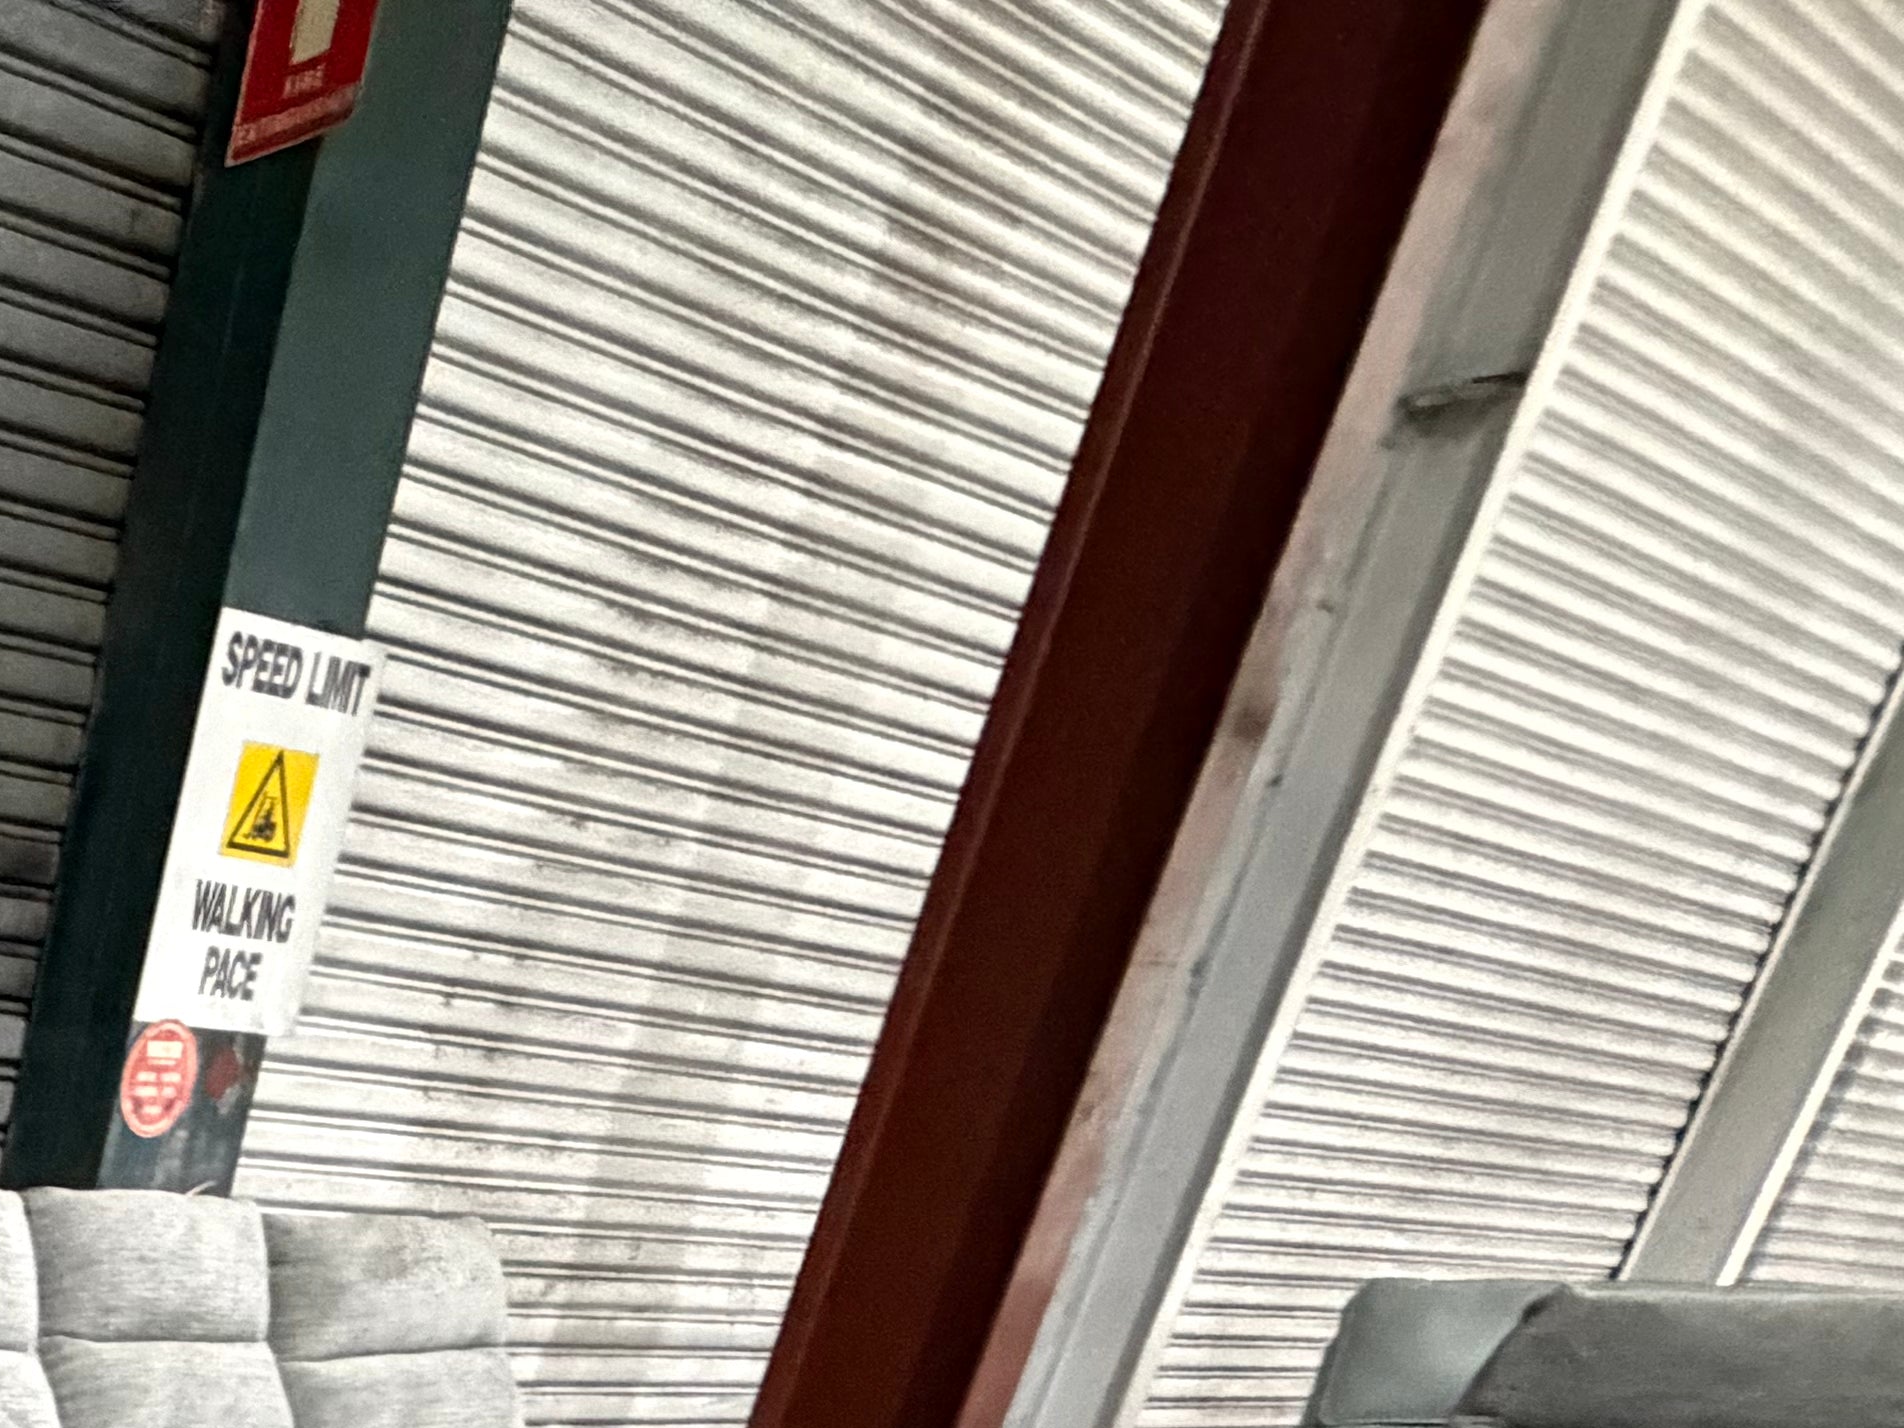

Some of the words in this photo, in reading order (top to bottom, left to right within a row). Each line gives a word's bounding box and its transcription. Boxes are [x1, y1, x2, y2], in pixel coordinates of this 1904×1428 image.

[221, 631, 304, 699] SPEED
[305, 651, 371, 717] LIMIT
[192, 878, 295, 943] WALKING
[198, 945, 263, 1001] PACE
